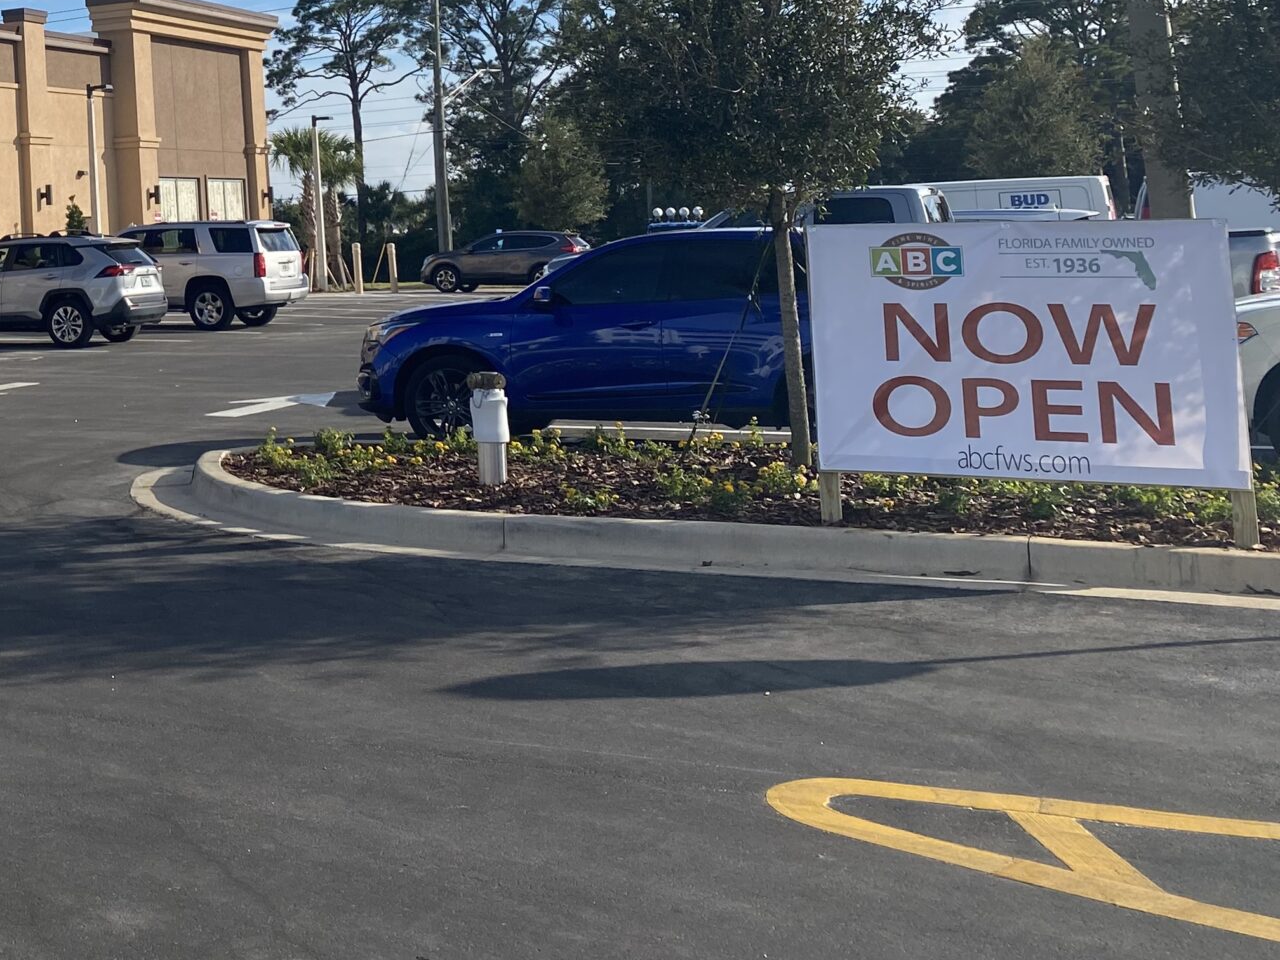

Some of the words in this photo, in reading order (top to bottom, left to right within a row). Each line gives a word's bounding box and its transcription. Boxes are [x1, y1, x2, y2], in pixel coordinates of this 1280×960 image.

[1010, 193, 1050, 207] BUD
[998, 238, 1052, 249] FLORIDA
[1055, 238, 1101, 249] FAMILY
[1102, 237, 1155, 249] OWNED
[875, 250, 958, 273] ABC
[1025, 258, 1050, 270] EST.
[1052, 258, 1101, 274] 1936
[883, 301, 1157, 367] NOW
[872, 375, 1177, 446] OPEN
[957, 444, 1091, 475] abcfws.com
